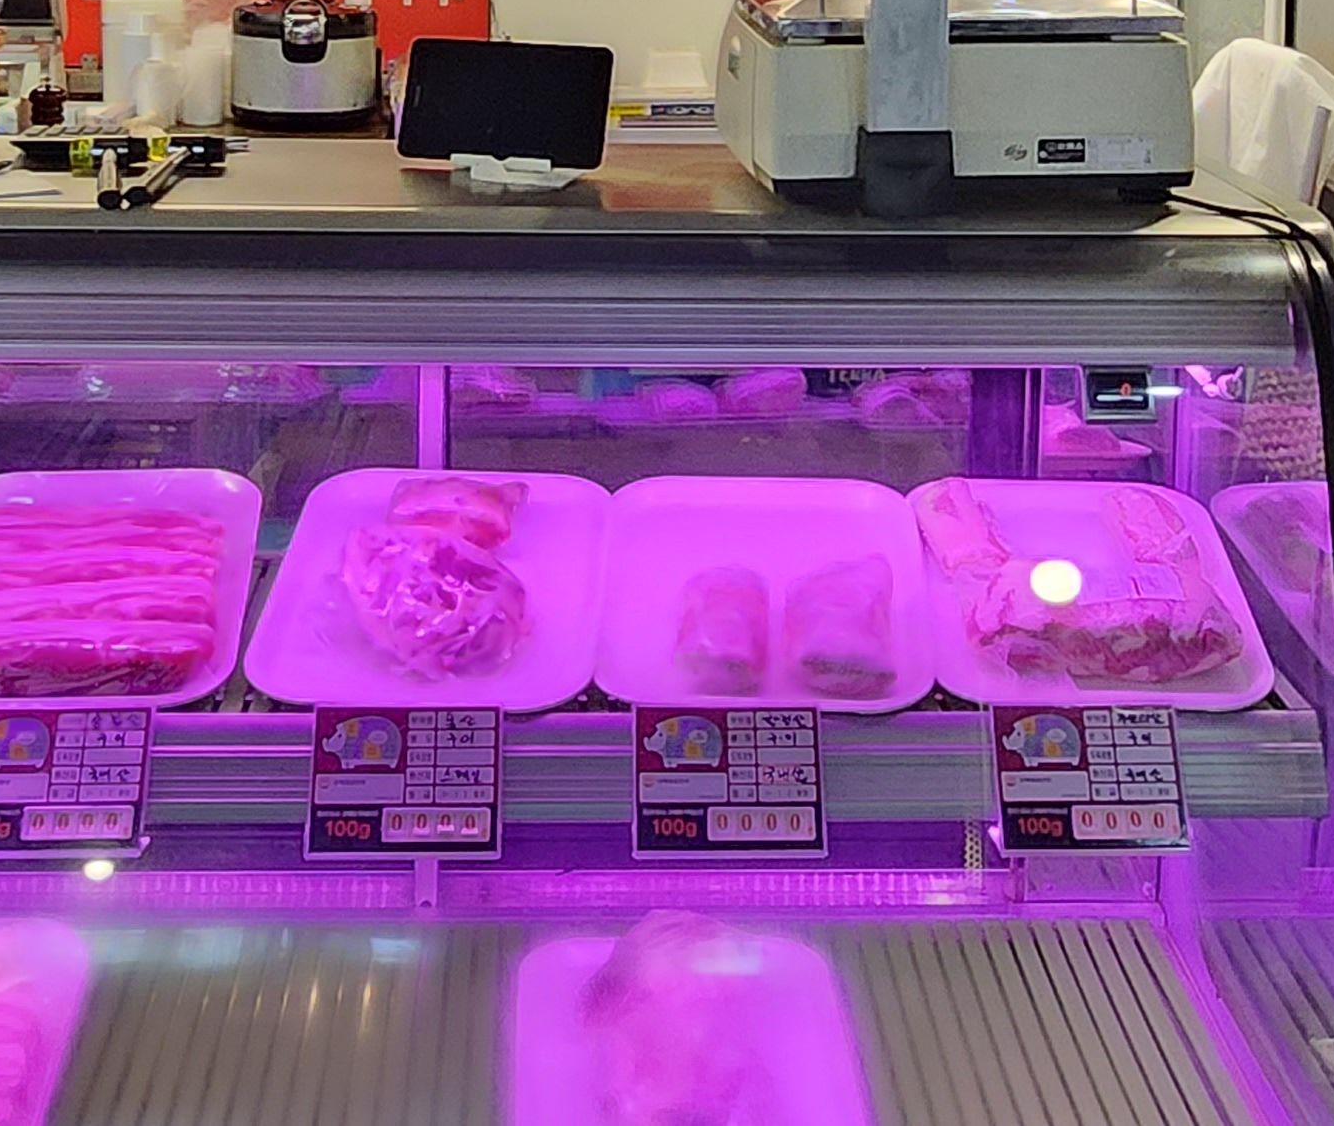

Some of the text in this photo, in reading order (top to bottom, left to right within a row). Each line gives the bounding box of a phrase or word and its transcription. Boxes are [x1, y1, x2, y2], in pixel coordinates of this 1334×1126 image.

[324, 820, 372, 840] 100g
[652, 818, 698, 838] 100g
[1017, 817, 1064, 837] 100g
